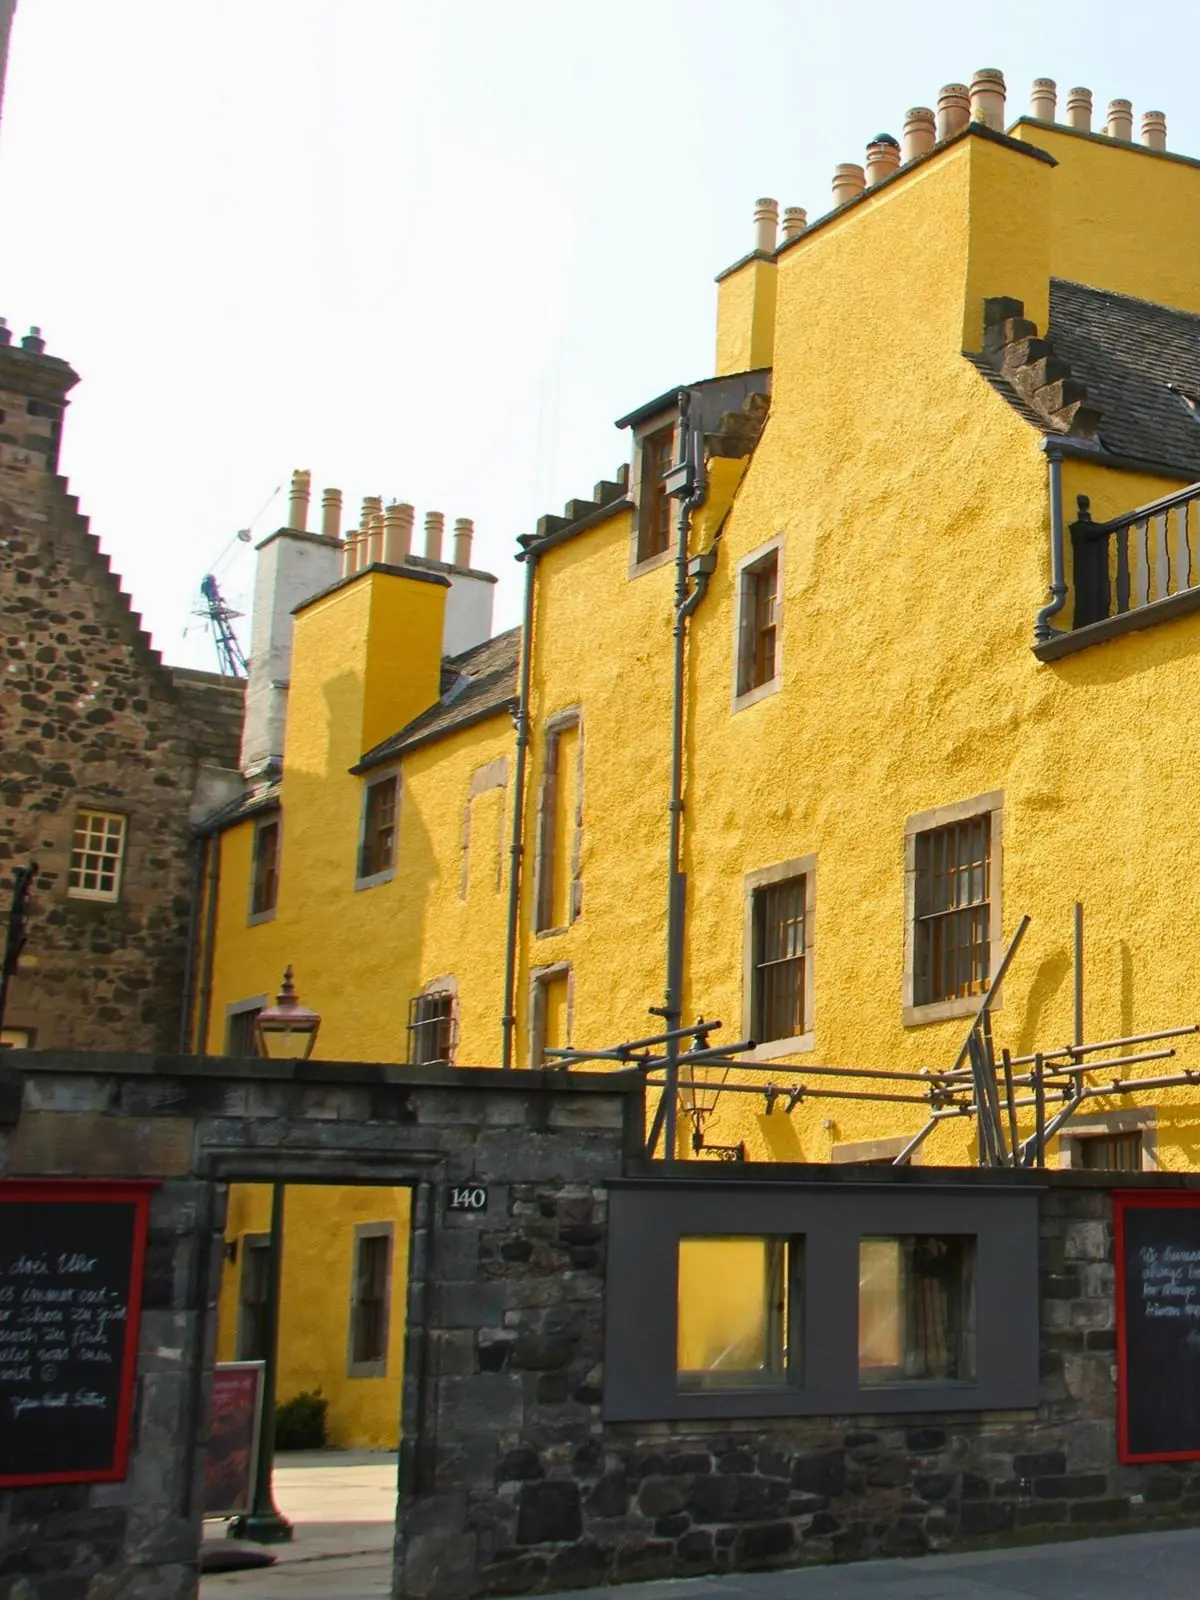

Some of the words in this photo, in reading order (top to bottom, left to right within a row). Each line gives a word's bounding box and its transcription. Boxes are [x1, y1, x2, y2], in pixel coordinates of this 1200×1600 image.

[450, 1187, 486, 1208] 140
[8, 1252, 51, 1276] drei
[57, 1253, 99, 1274] Uhr
